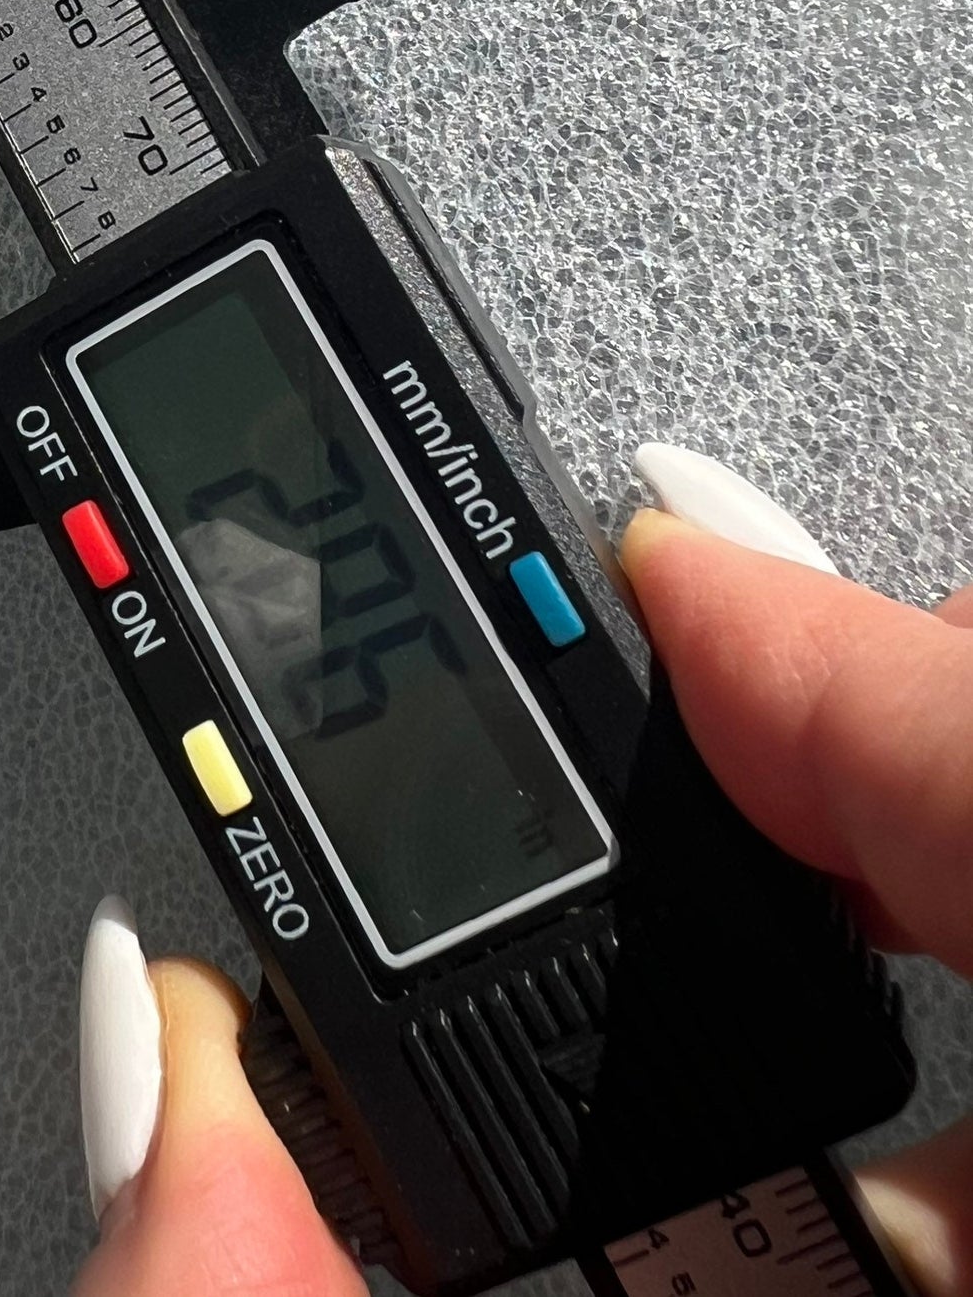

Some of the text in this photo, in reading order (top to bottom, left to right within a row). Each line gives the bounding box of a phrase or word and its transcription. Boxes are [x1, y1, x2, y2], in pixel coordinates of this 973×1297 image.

[13, 52, 30, 71] 3
[31, 88, 46, 102] 4
[47, 115, 65, 134] 5
[81, 177, 98, 191] 7
[98, 211, 115, 229] 8
[124, 116, 167, 175] 70
[16, 405, 78, 481] OFF
[383, 360, 516, 559] mm/inch
[111, 590, 166, 658] ON
[225, 816, 309, 940] ZERO
